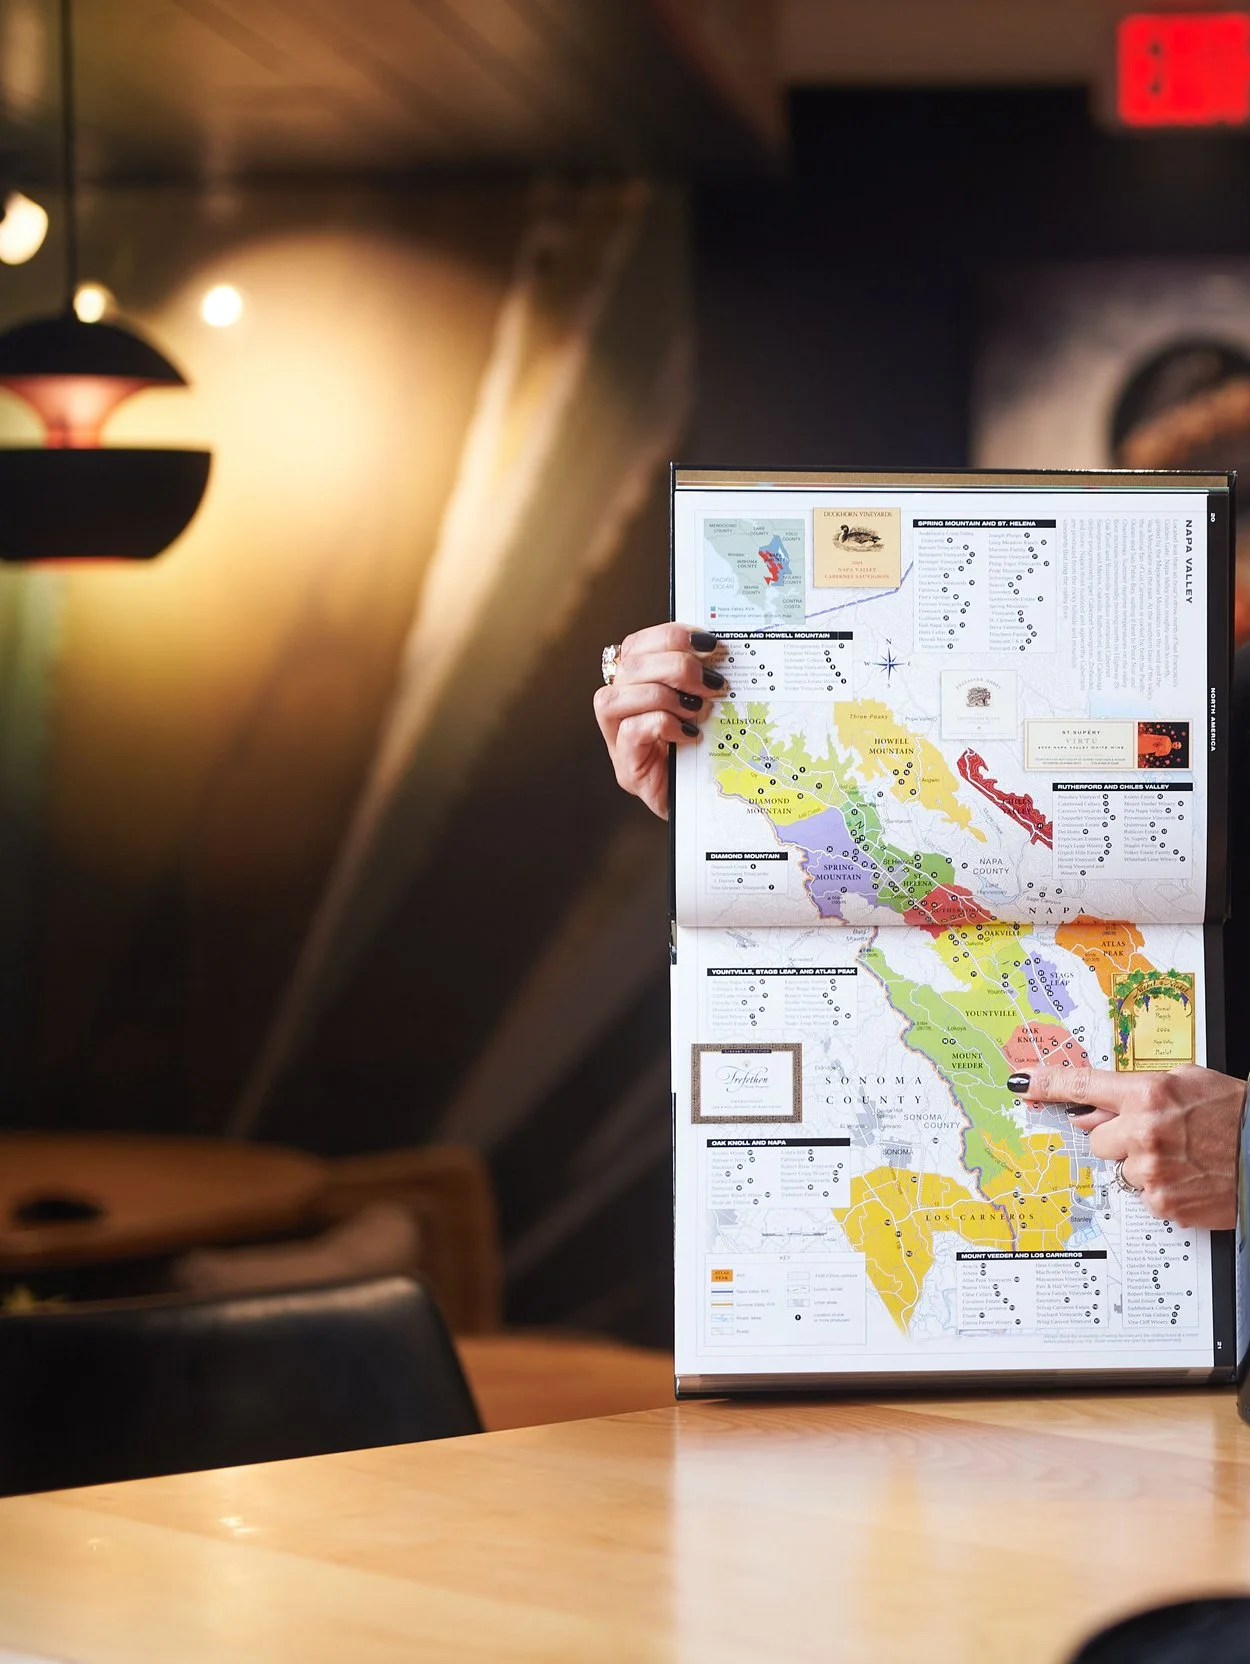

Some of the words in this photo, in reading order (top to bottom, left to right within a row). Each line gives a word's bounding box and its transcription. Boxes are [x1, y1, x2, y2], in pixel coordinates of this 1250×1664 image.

[1210, 512, 1216, 522] 20
[1185, 519, 1193, 553] NAPA
[1185, 557, 1193, 604] VALLEY
[1050, 979, 1070, 987] LEAP
[825, 1076, 922, 1085] SONOMA
[826, 1096, 922, 1104] COUNTY
[903, 1113, 943, 1121] SONOMA
[960, 1213, 1034, 1221] CARNEROS
